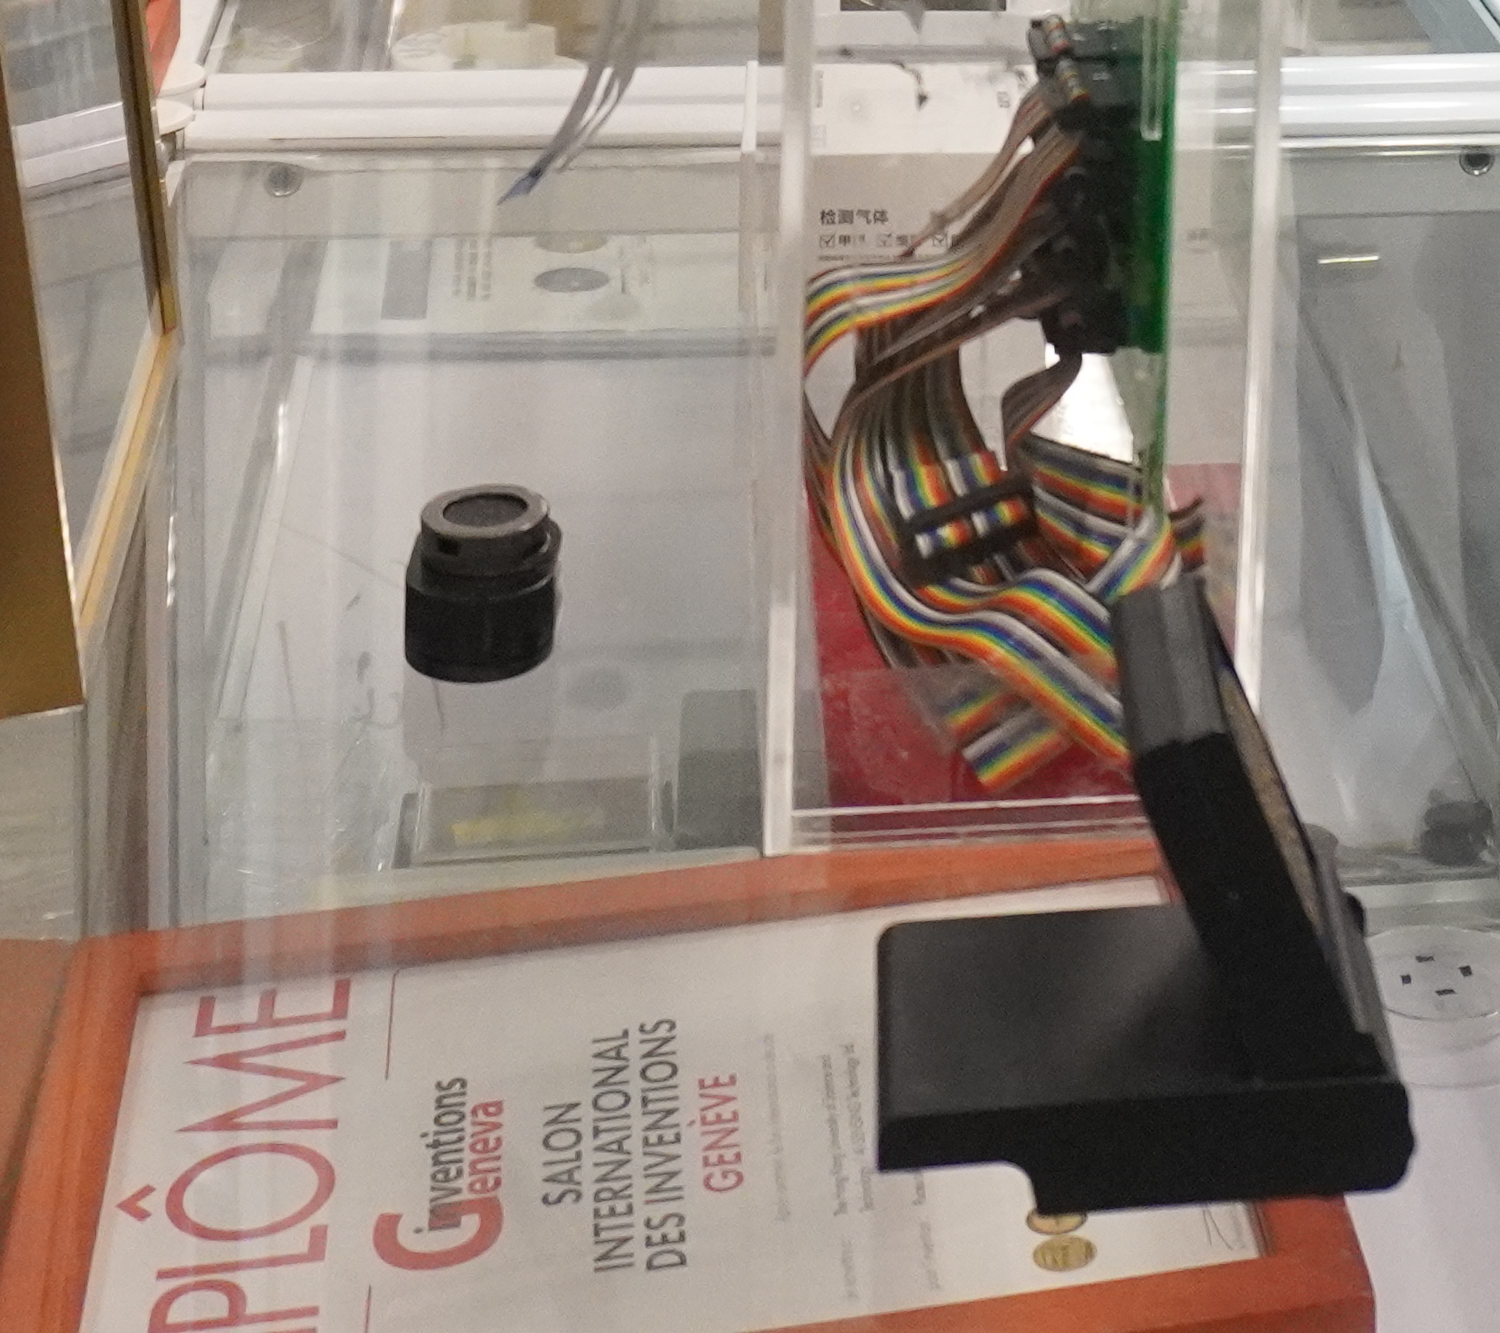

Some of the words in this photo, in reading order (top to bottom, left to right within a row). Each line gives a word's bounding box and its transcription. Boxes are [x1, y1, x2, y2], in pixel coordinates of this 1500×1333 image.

[820, 208, 889, 225] 检测气体
[116, 977, 350, 1333] PLÔME
[413, 1076, 468, 1234] inventions
[542, 1100, 583, 1207] SALON
[591, 1028, 636, 1273] INTERNATIONAL
[638, 1017, 685, 1206] INVENTIONS
[688, 1072, 744, 1194] GENÈVE
[645, 1209, 688, 1273] DES
